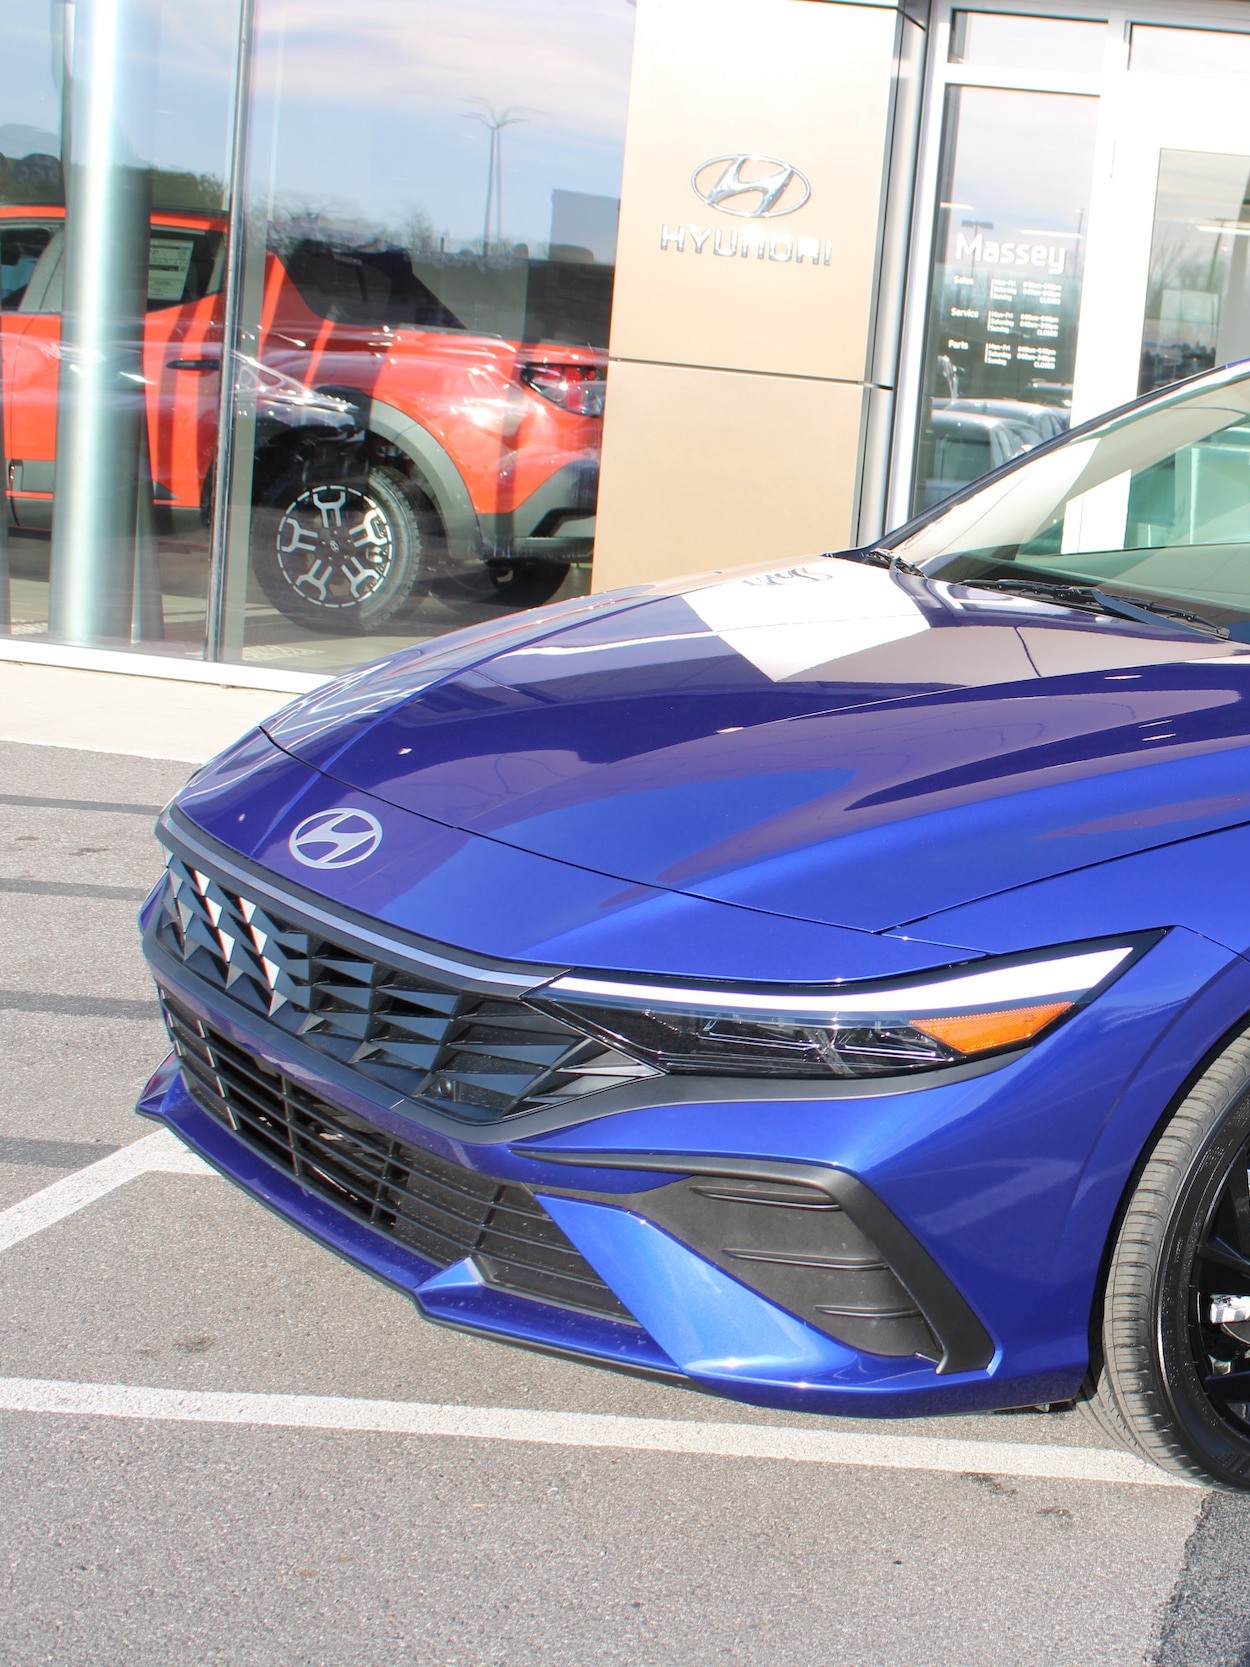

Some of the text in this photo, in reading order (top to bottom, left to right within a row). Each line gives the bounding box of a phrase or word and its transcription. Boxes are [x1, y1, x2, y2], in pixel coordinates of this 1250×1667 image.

[660, 224, 832, 266] HYUNDAI
[955, 232, 1066, 275] Massey
[953, 275, 974, 286] Sales
[950, 307, 979, 319] Service
[1036, 329, 1058, 338] CLOSED
[948, 339, 969, 350] Parts
[1033, 361, 1056, 370] CLOSED
